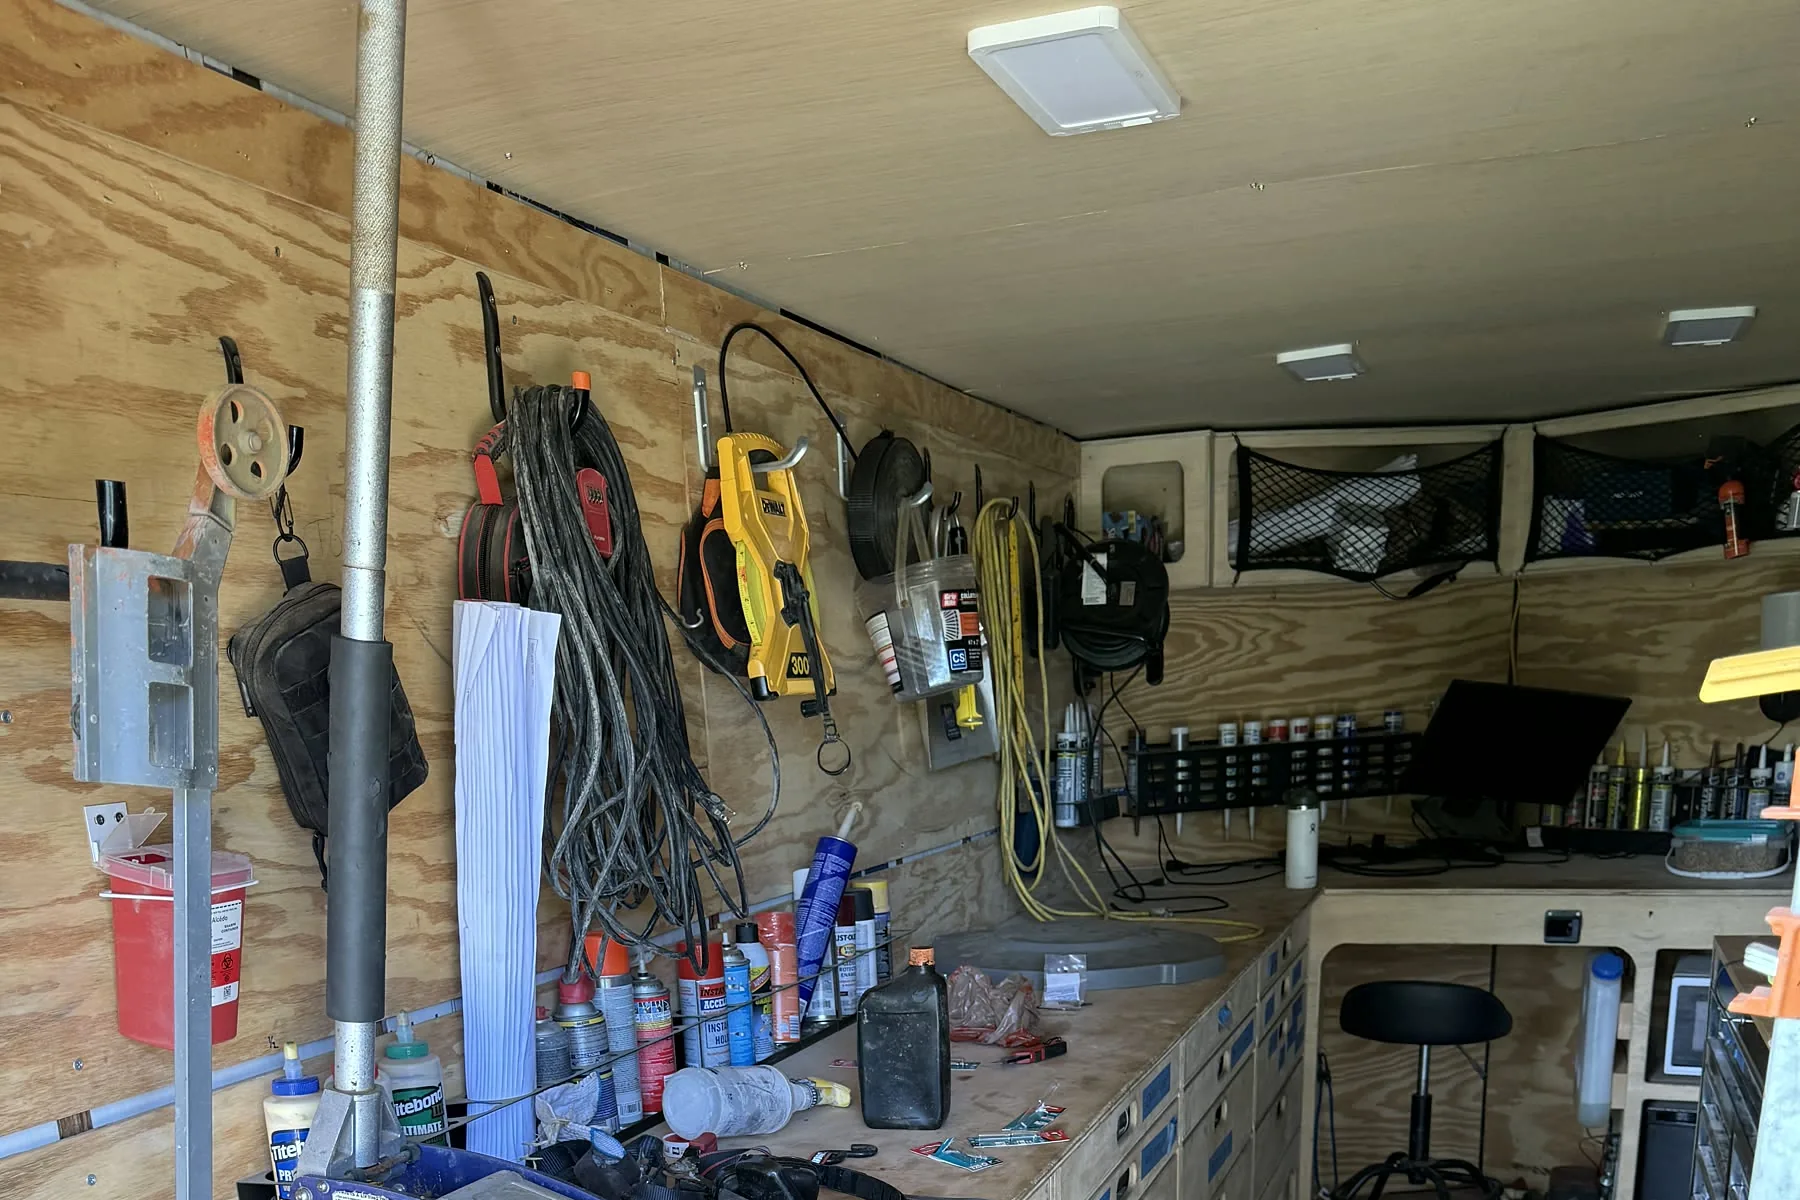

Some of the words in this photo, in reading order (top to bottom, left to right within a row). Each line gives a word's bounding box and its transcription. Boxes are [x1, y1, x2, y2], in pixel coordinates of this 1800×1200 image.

[791, 655, 809, 675] 300
[952, 652, 966, 663] CS
[393, 1084, 443, 1118] itebond
[401, 1120, 443, 1138] LTIMATE
